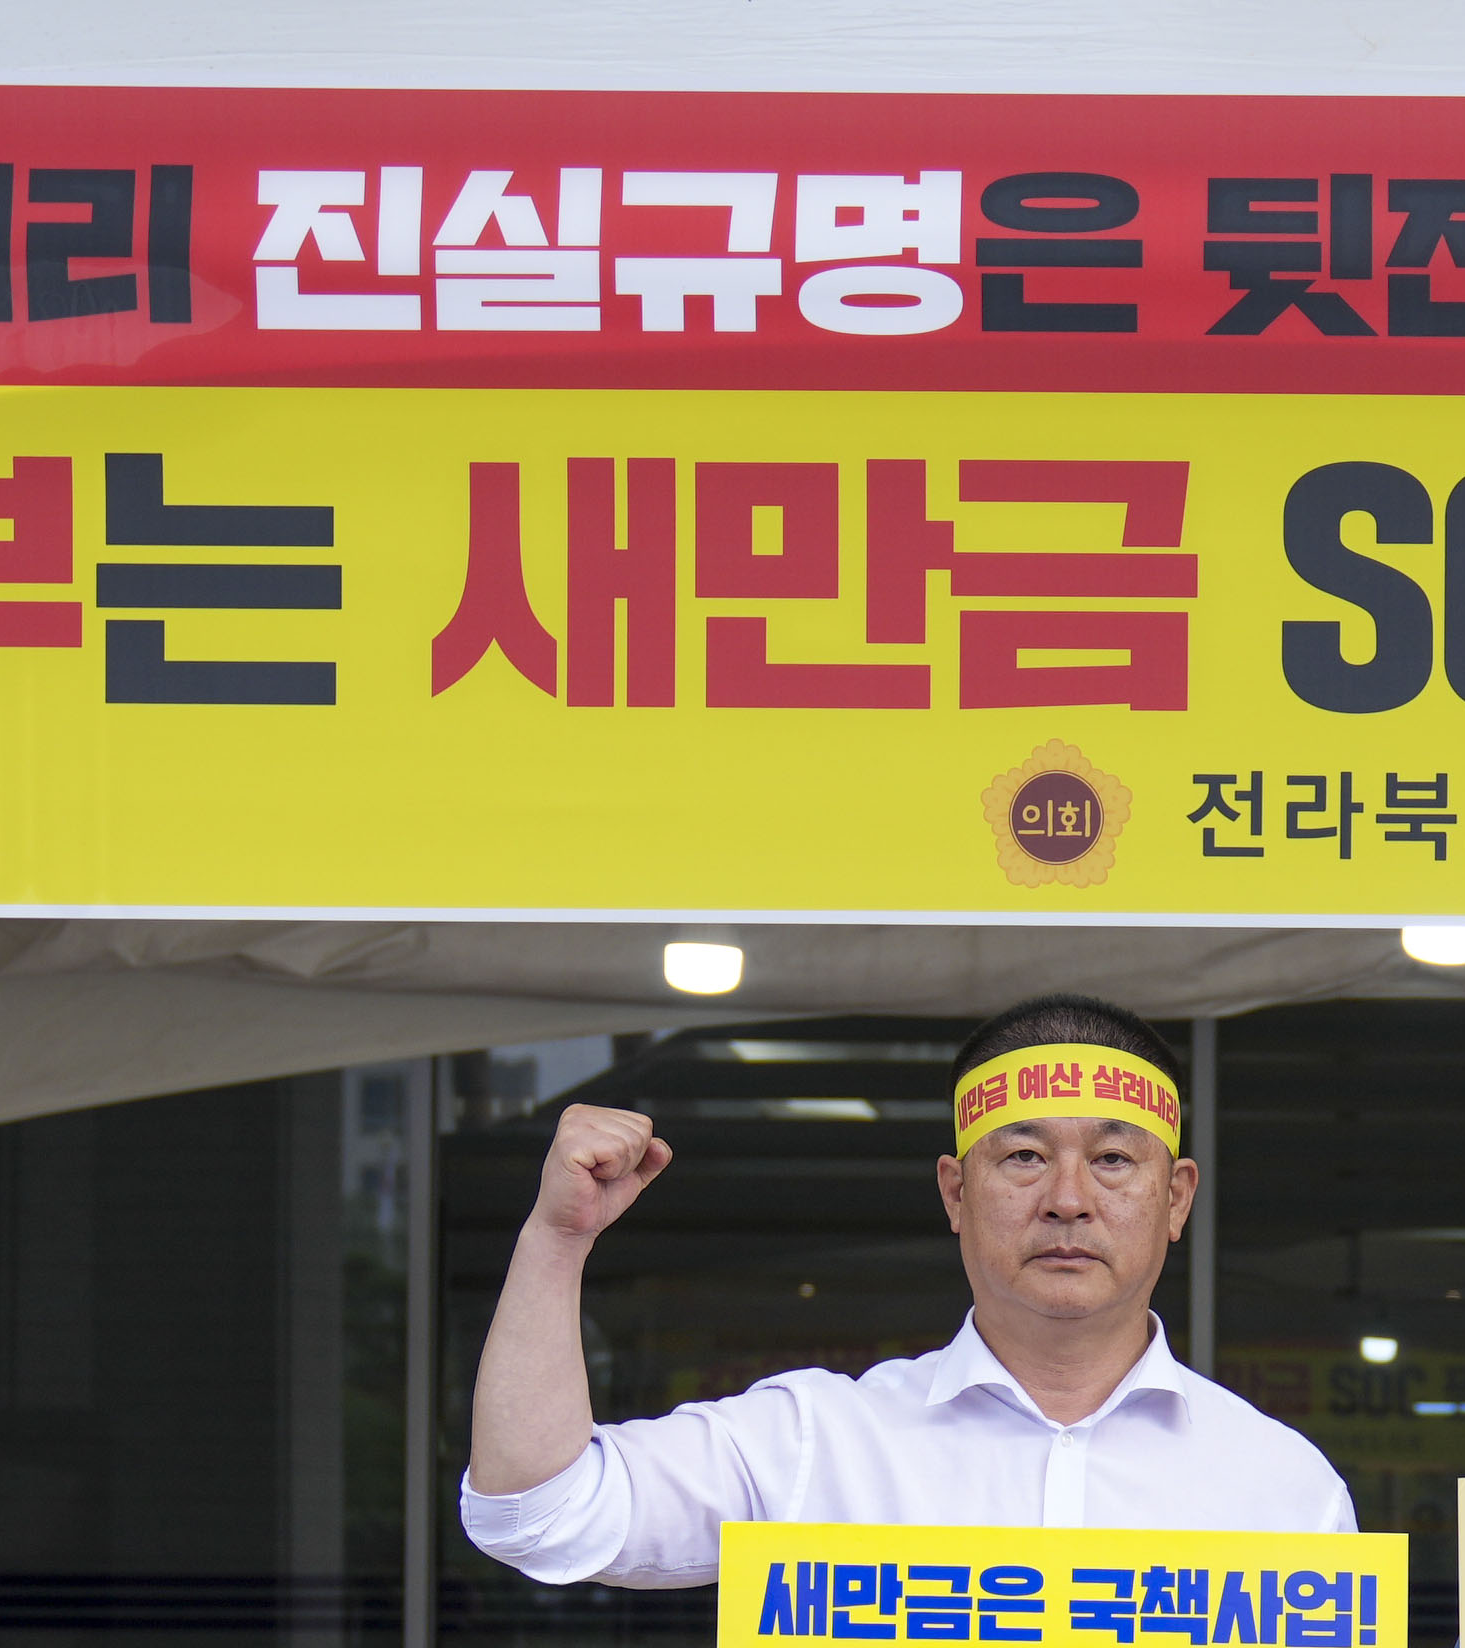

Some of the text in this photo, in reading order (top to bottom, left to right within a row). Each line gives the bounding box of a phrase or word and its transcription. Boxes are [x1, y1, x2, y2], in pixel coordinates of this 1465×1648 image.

[253, 166, 1144, 336] 진실규명은
[431, 457, 1199, 712] 새만금
[1017, 799, 1091, 838] 의회
[1018, 1063, 1083, 1100] 예산
[758, 1561, 1377, 1648] 새만금은 국책사업!
